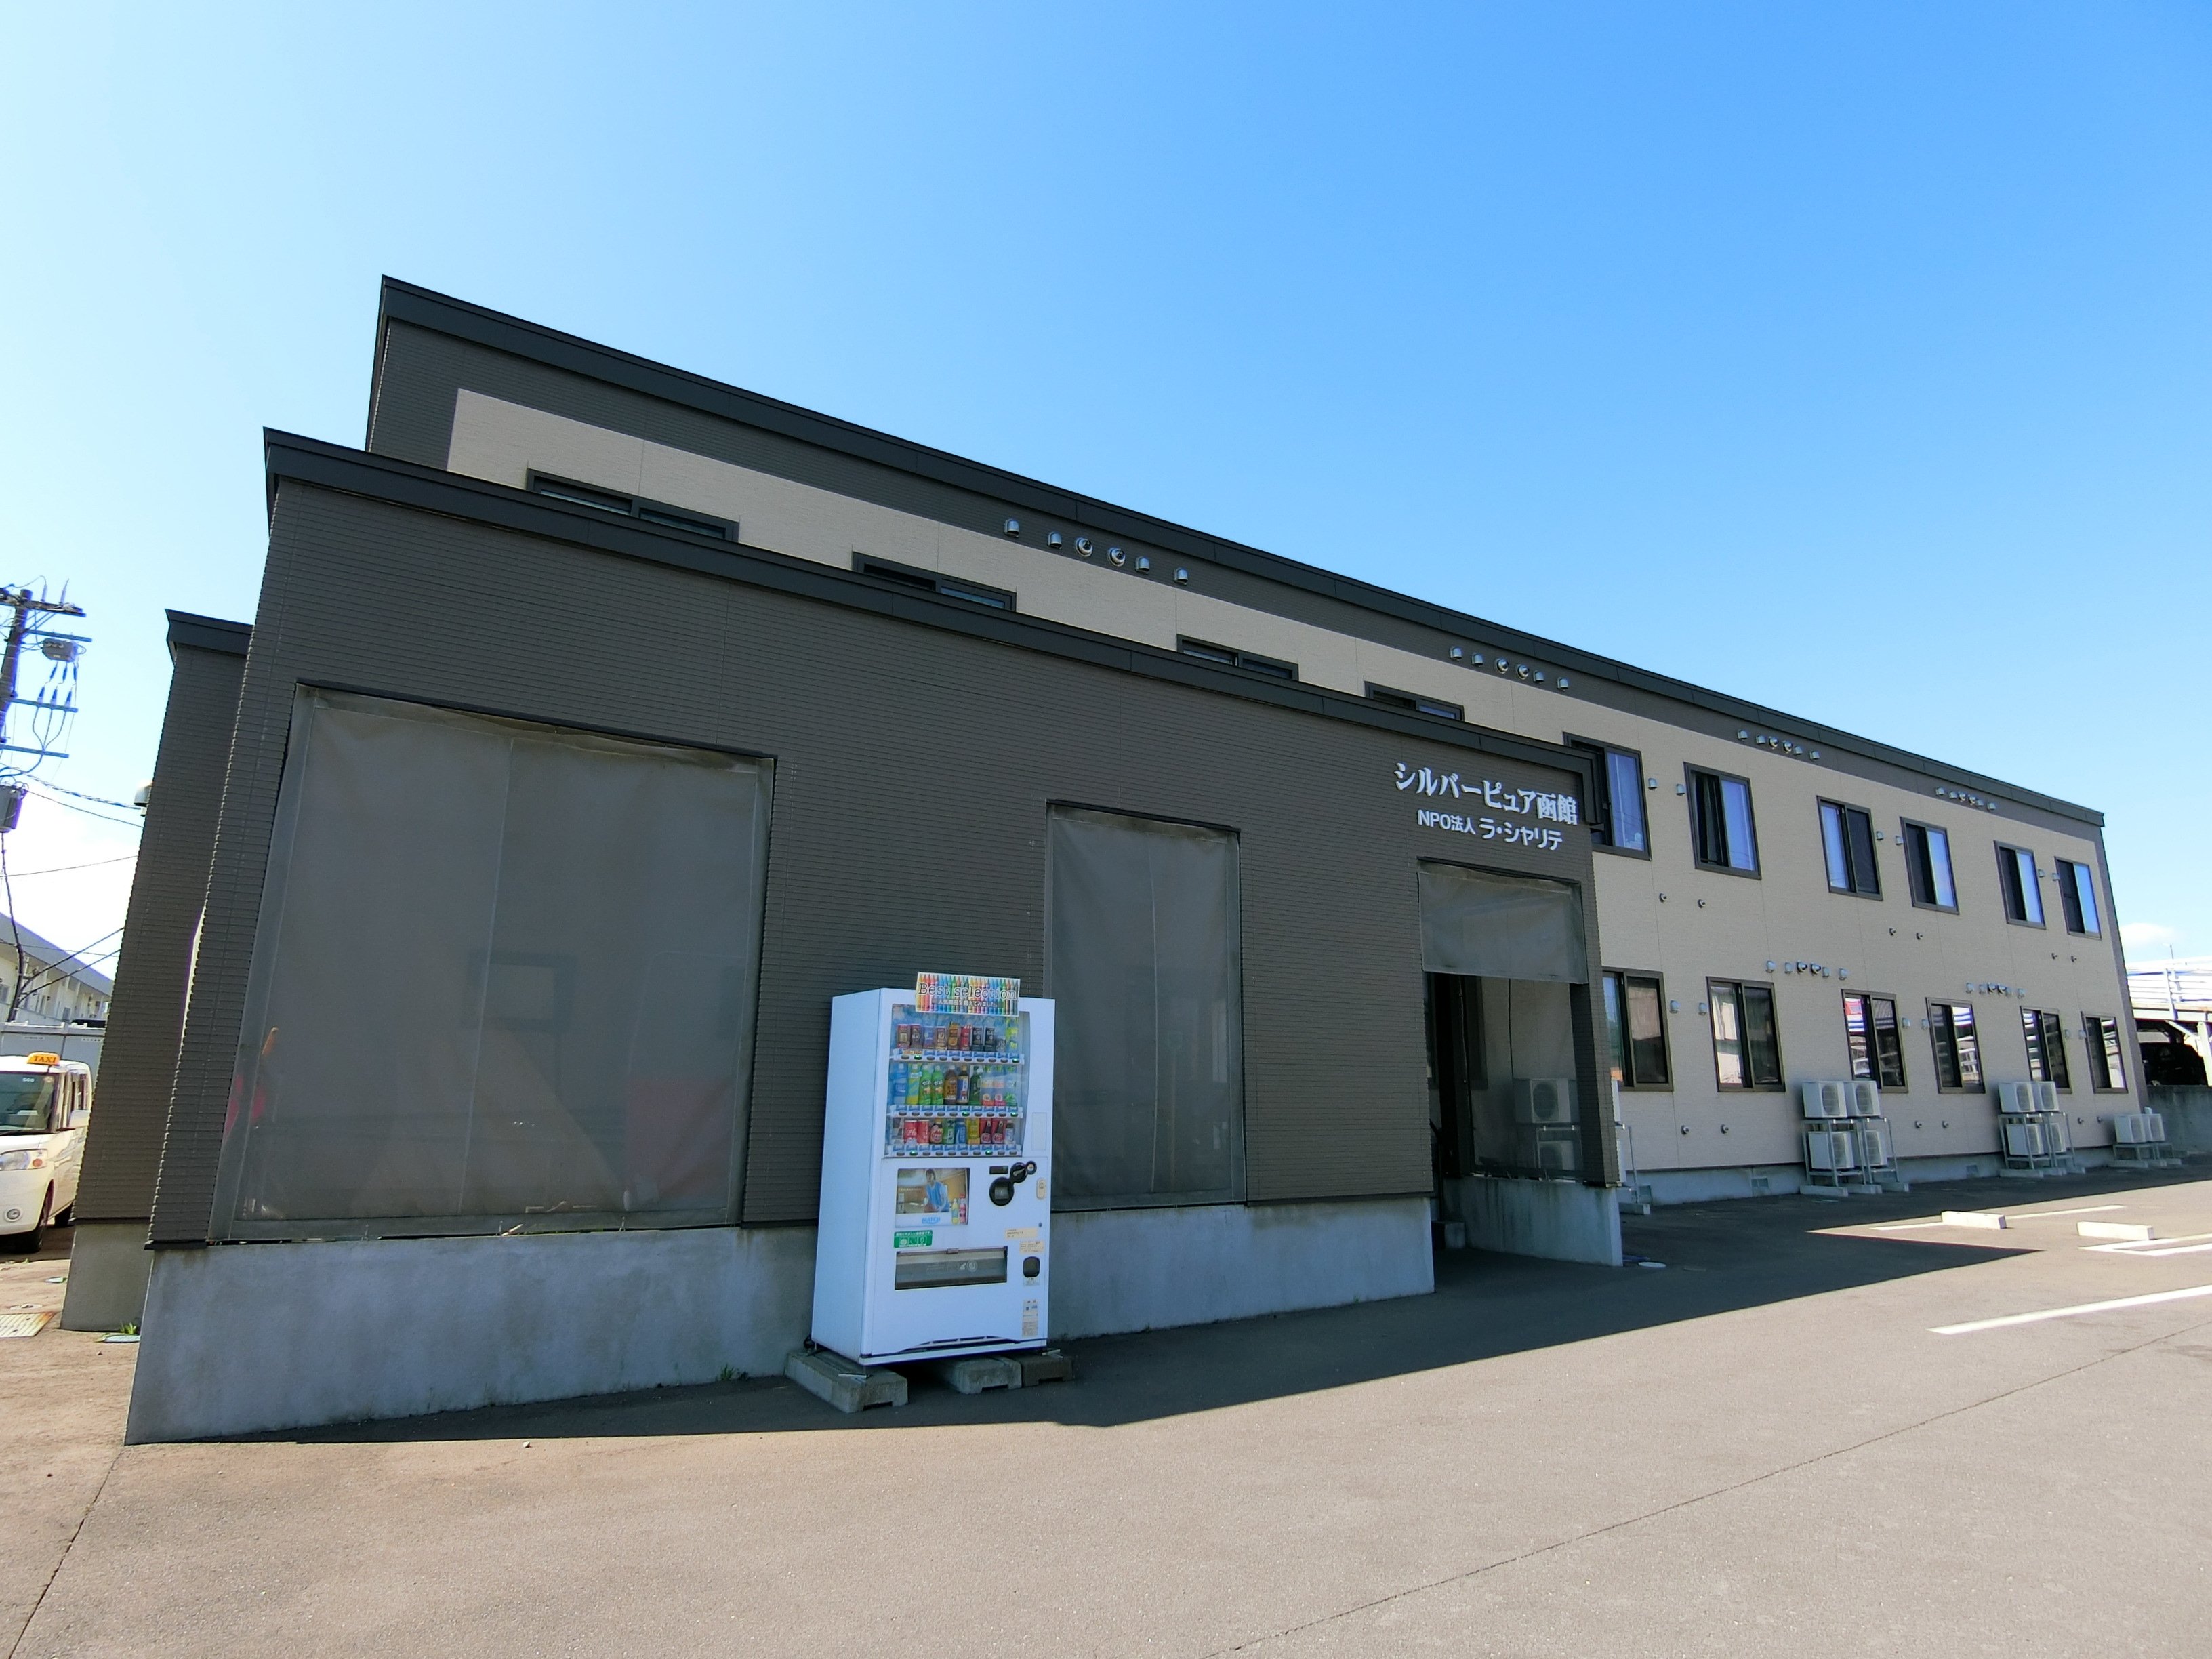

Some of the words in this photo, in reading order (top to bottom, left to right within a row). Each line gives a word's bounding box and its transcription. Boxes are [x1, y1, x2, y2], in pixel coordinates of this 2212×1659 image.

[1394, 762, 1578, 825] シルバーピュア函館
[1417, 809, 1476, 834] NPO法人
[918, 983, 949, 996] Best
[954, 985, 1017, 1000] selection
